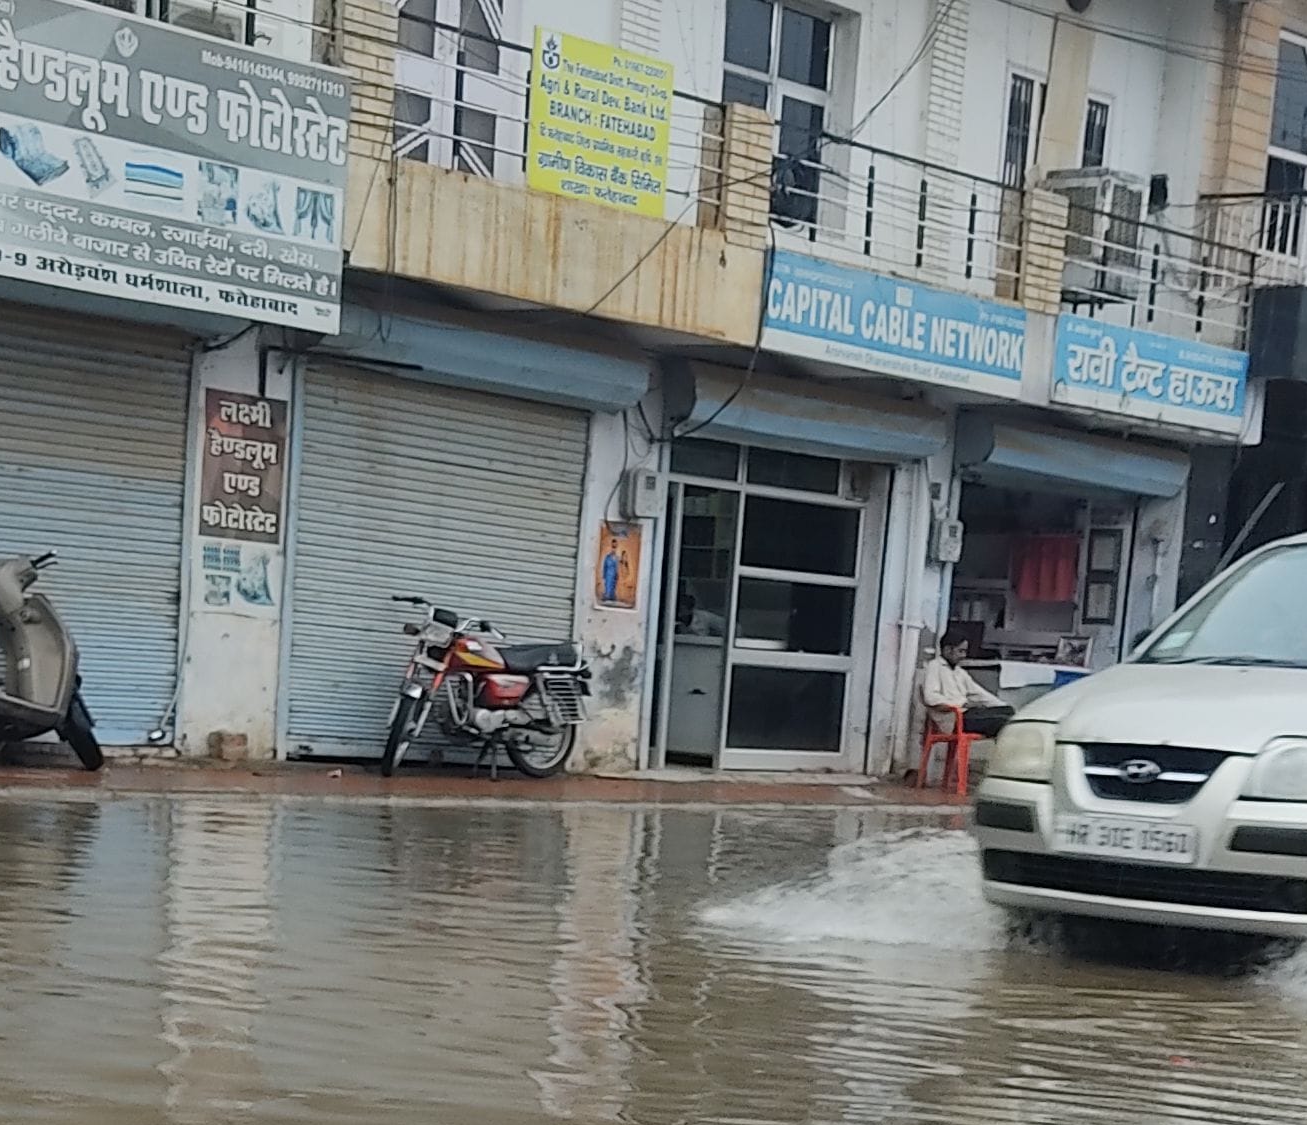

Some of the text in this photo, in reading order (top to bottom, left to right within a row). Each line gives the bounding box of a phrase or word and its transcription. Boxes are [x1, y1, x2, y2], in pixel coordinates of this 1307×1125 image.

[139, 69, 209, 135] एण्ड
[217, 79, 348, 166] फोटोस्टेट
[574, 82, 599, 103] Rural
[624, 96, 646, 115] Bank
[550, 100, 592, 125] BRANCH
[600, 113, 655, 141] FATEHABAD
[132, 242, 151, 262] से
[154, 246, 202, 272] उचित
[236, 264, 261, 283] पर
[263, 264, 313, 292] मिलते
[767, 277, 1024, 371] CAPITAL CABLE NETWORK
[1067, 335, 1118, 387] रावी
[1168, 364, 1239, 410] हाऊस
[219, 400, 272, 428] लक्ष्मी
[208, 428, 277, 469] हैण्डलूम
[223, 472, 261, 497] एण्ड
[202, 501, 277, 534] फोटोस्टेट
